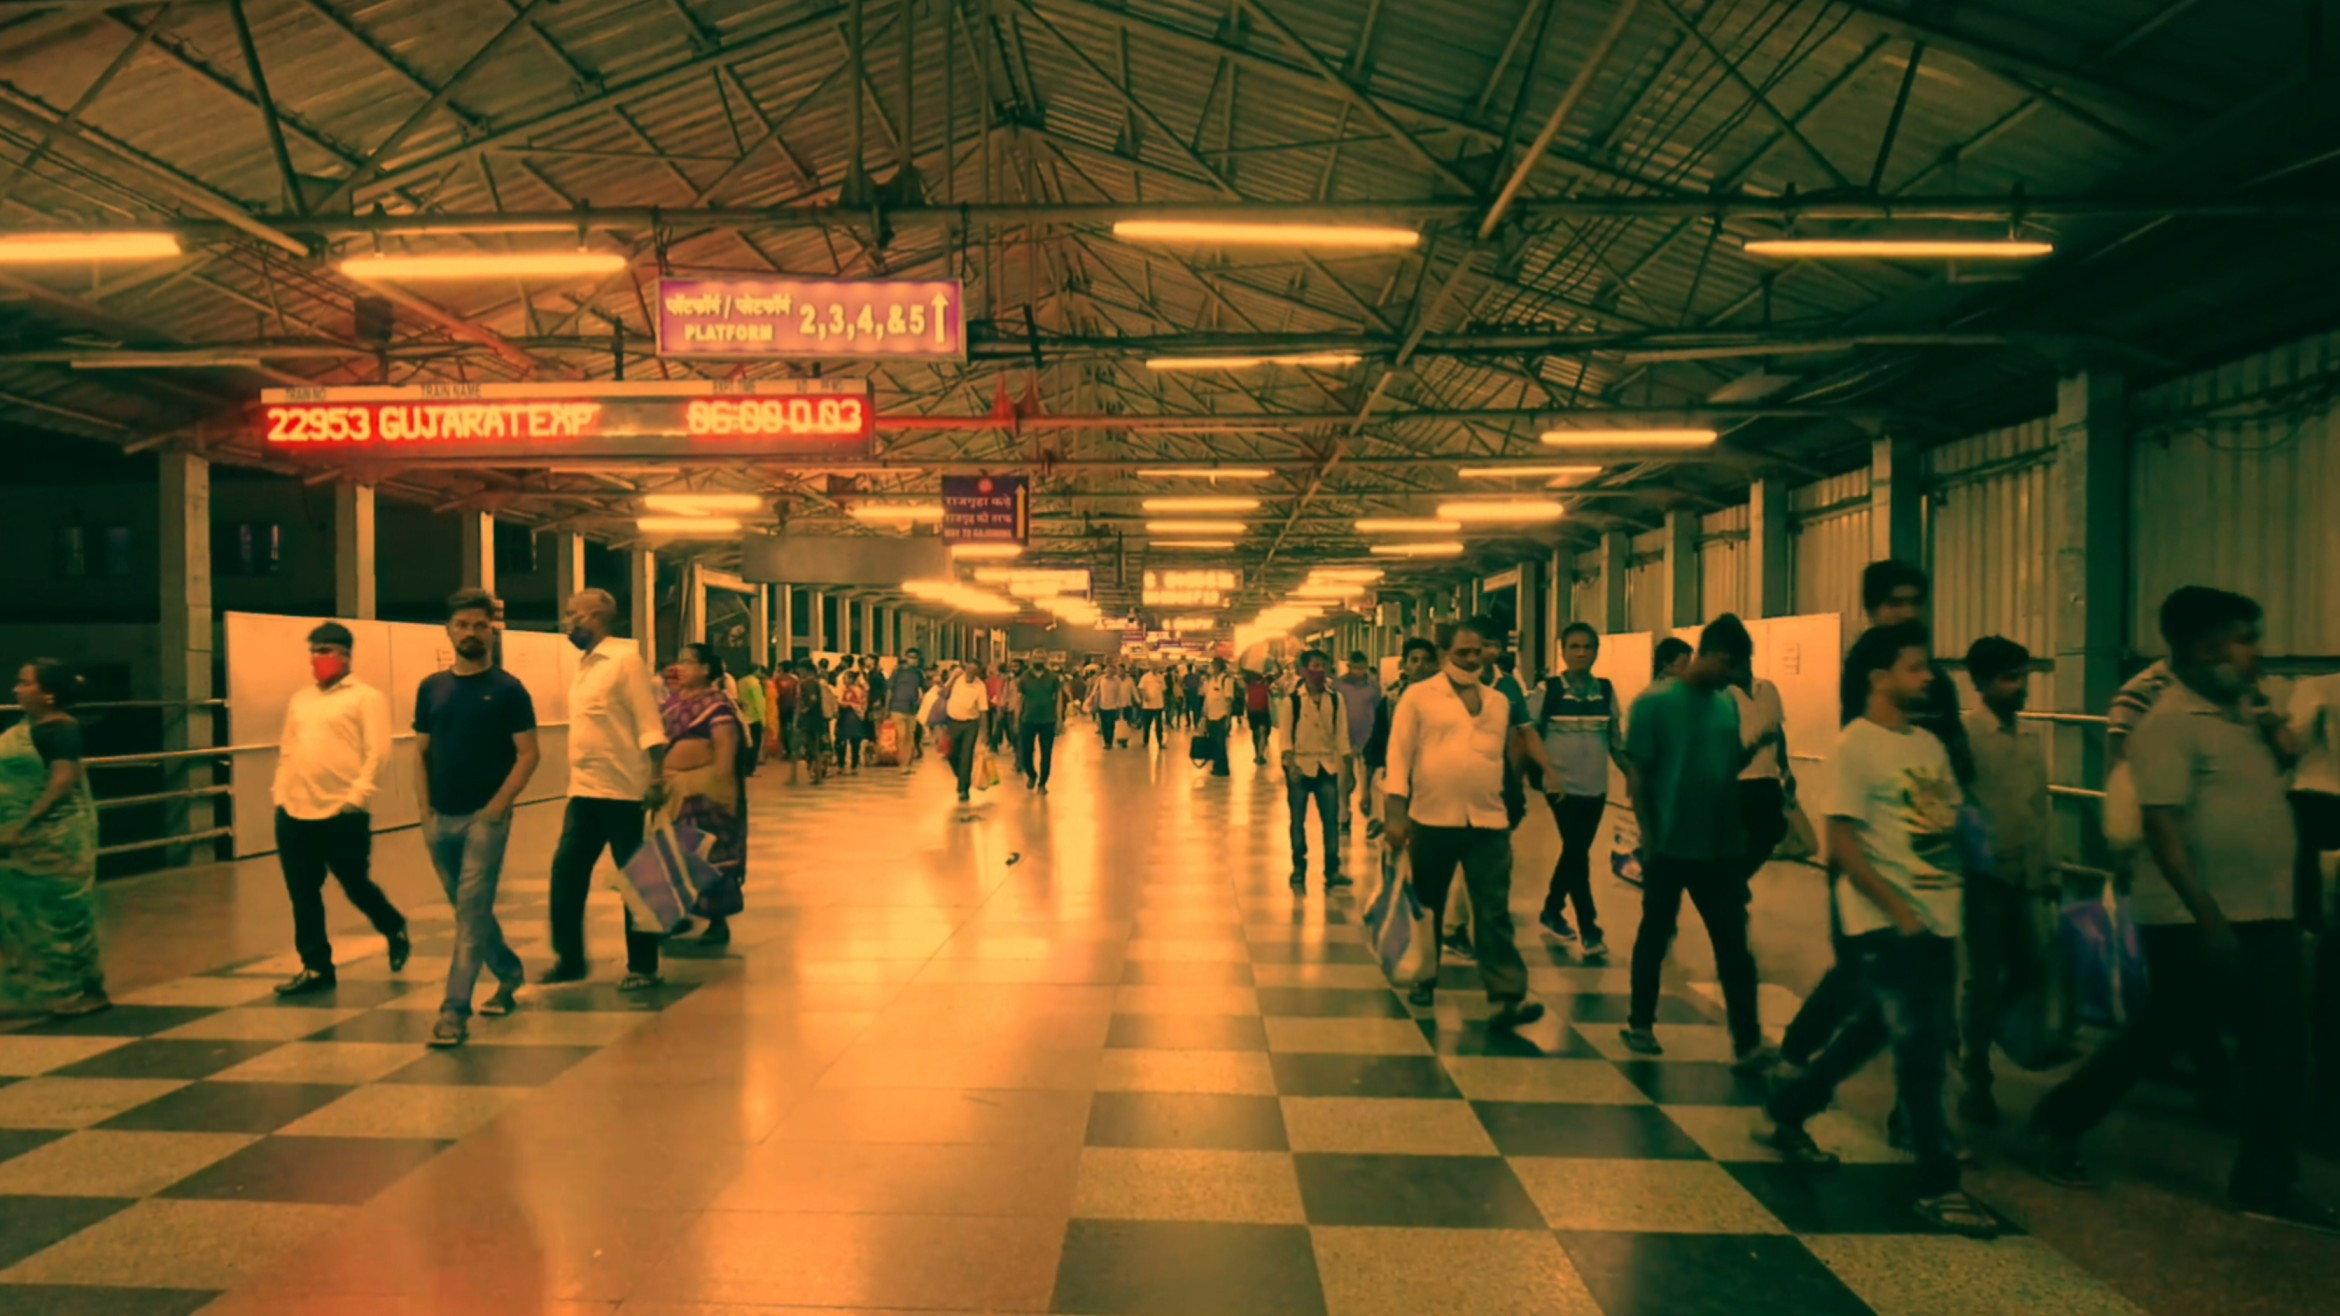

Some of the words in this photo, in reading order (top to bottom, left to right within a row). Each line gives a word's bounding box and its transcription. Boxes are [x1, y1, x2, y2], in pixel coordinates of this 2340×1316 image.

[684, 323, 774, 341] PLATFORM
[799, 303, 926, 342] 2,3,4,&5
[267, 407, 372, 442] 22953
